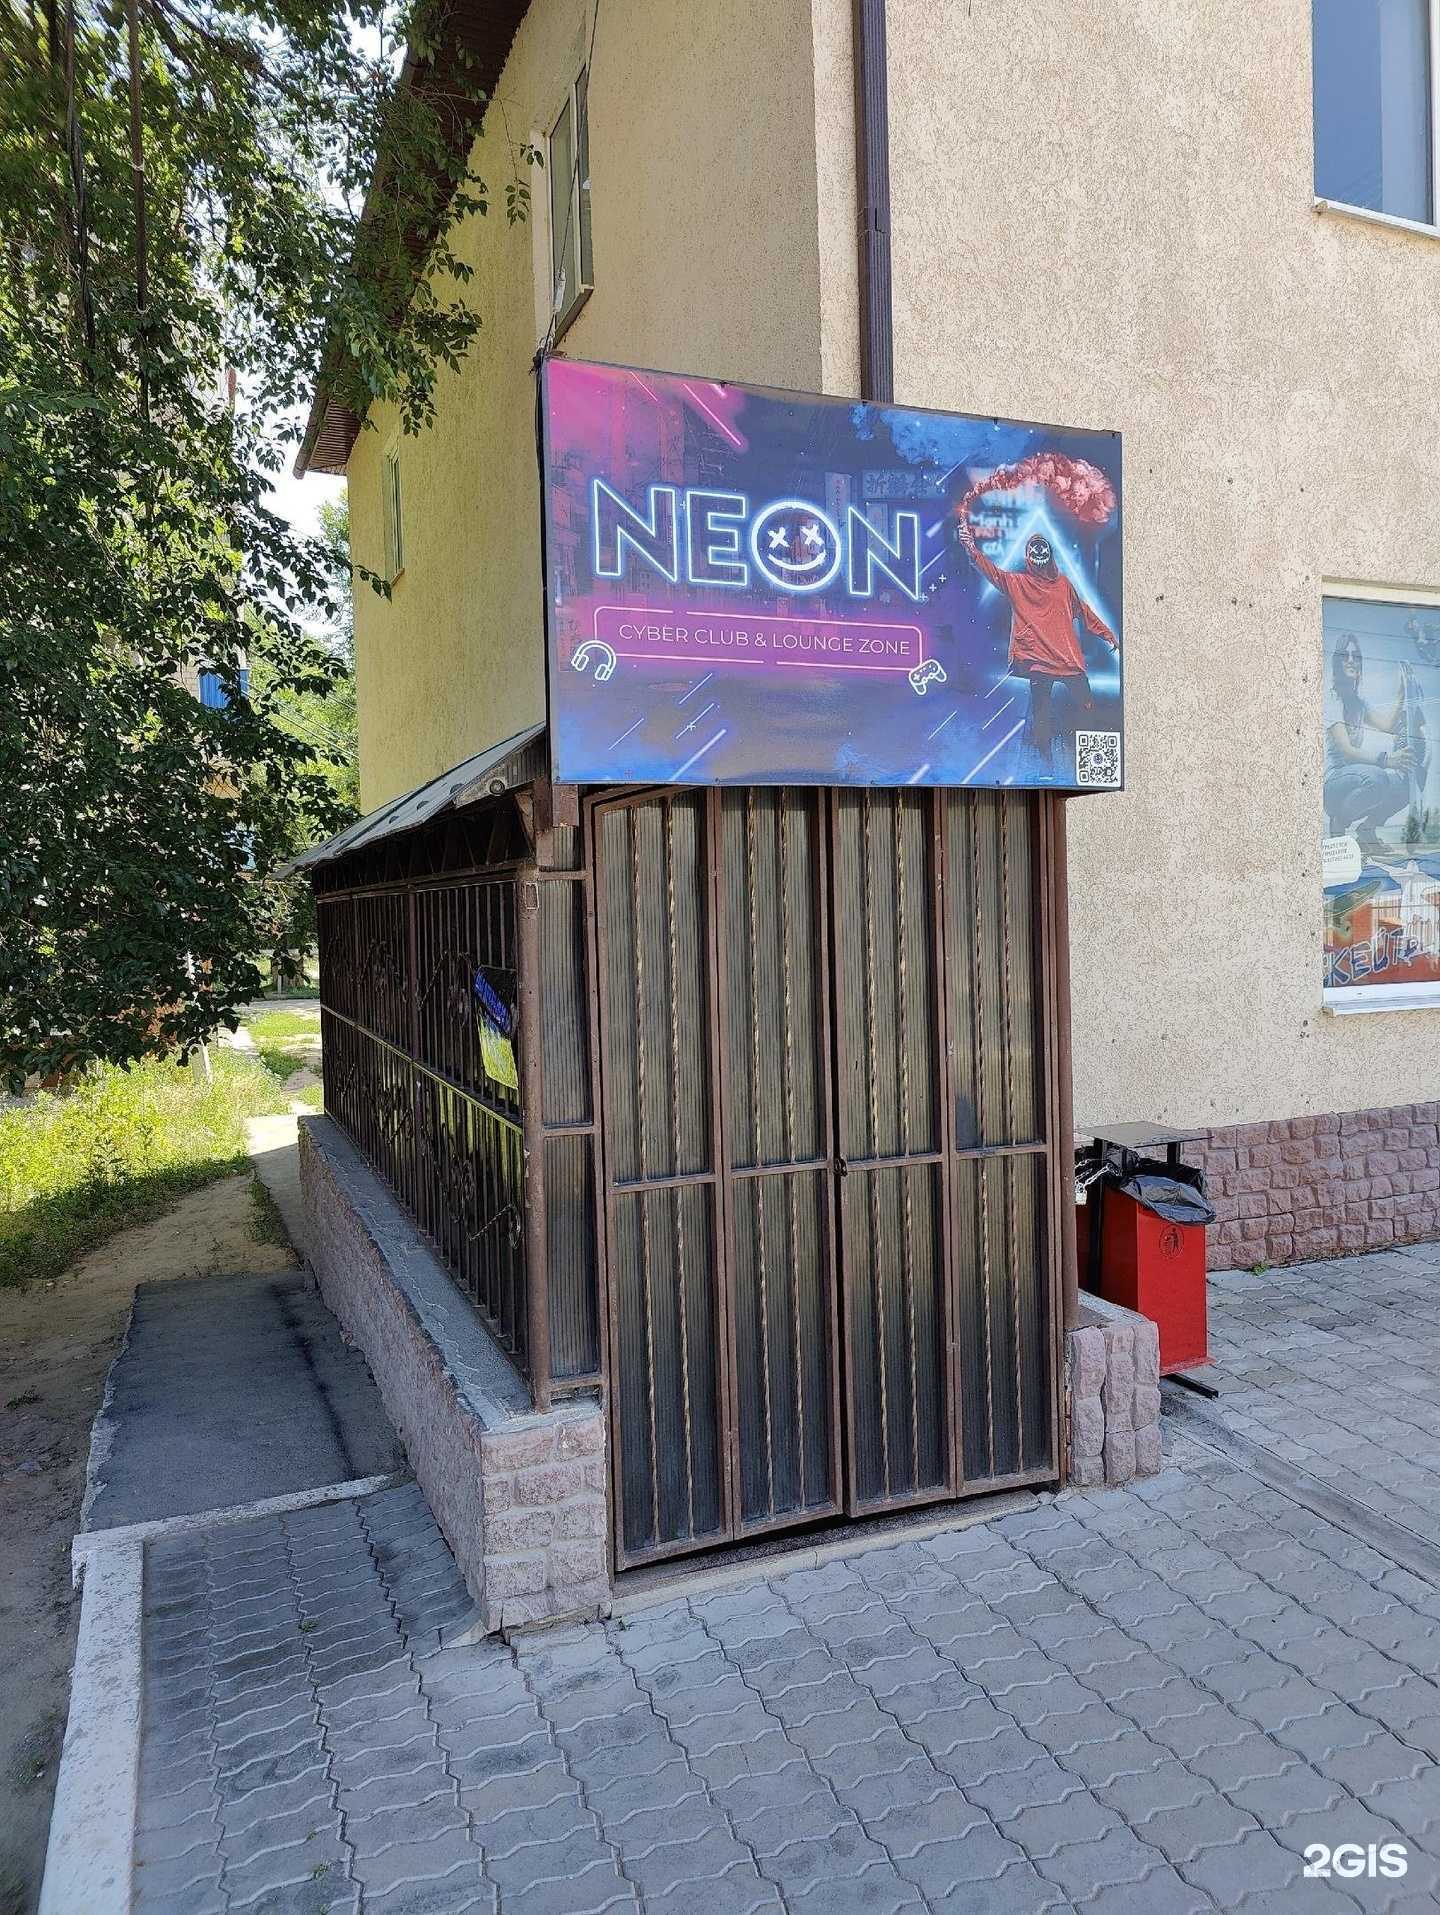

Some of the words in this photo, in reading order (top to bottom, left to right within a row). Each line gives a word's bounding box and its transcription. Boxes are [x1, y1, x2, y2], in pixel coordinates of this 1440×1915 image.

[592, 478, 918, 600] NEON
[619, 624, 689, 643] CYBER
[694, 628, 749, 646] CLUB
[754, 632, 767, 647] &
[773, 633, 853, 652] LOUNGE
[858, 638, 910, 655] ZONE
